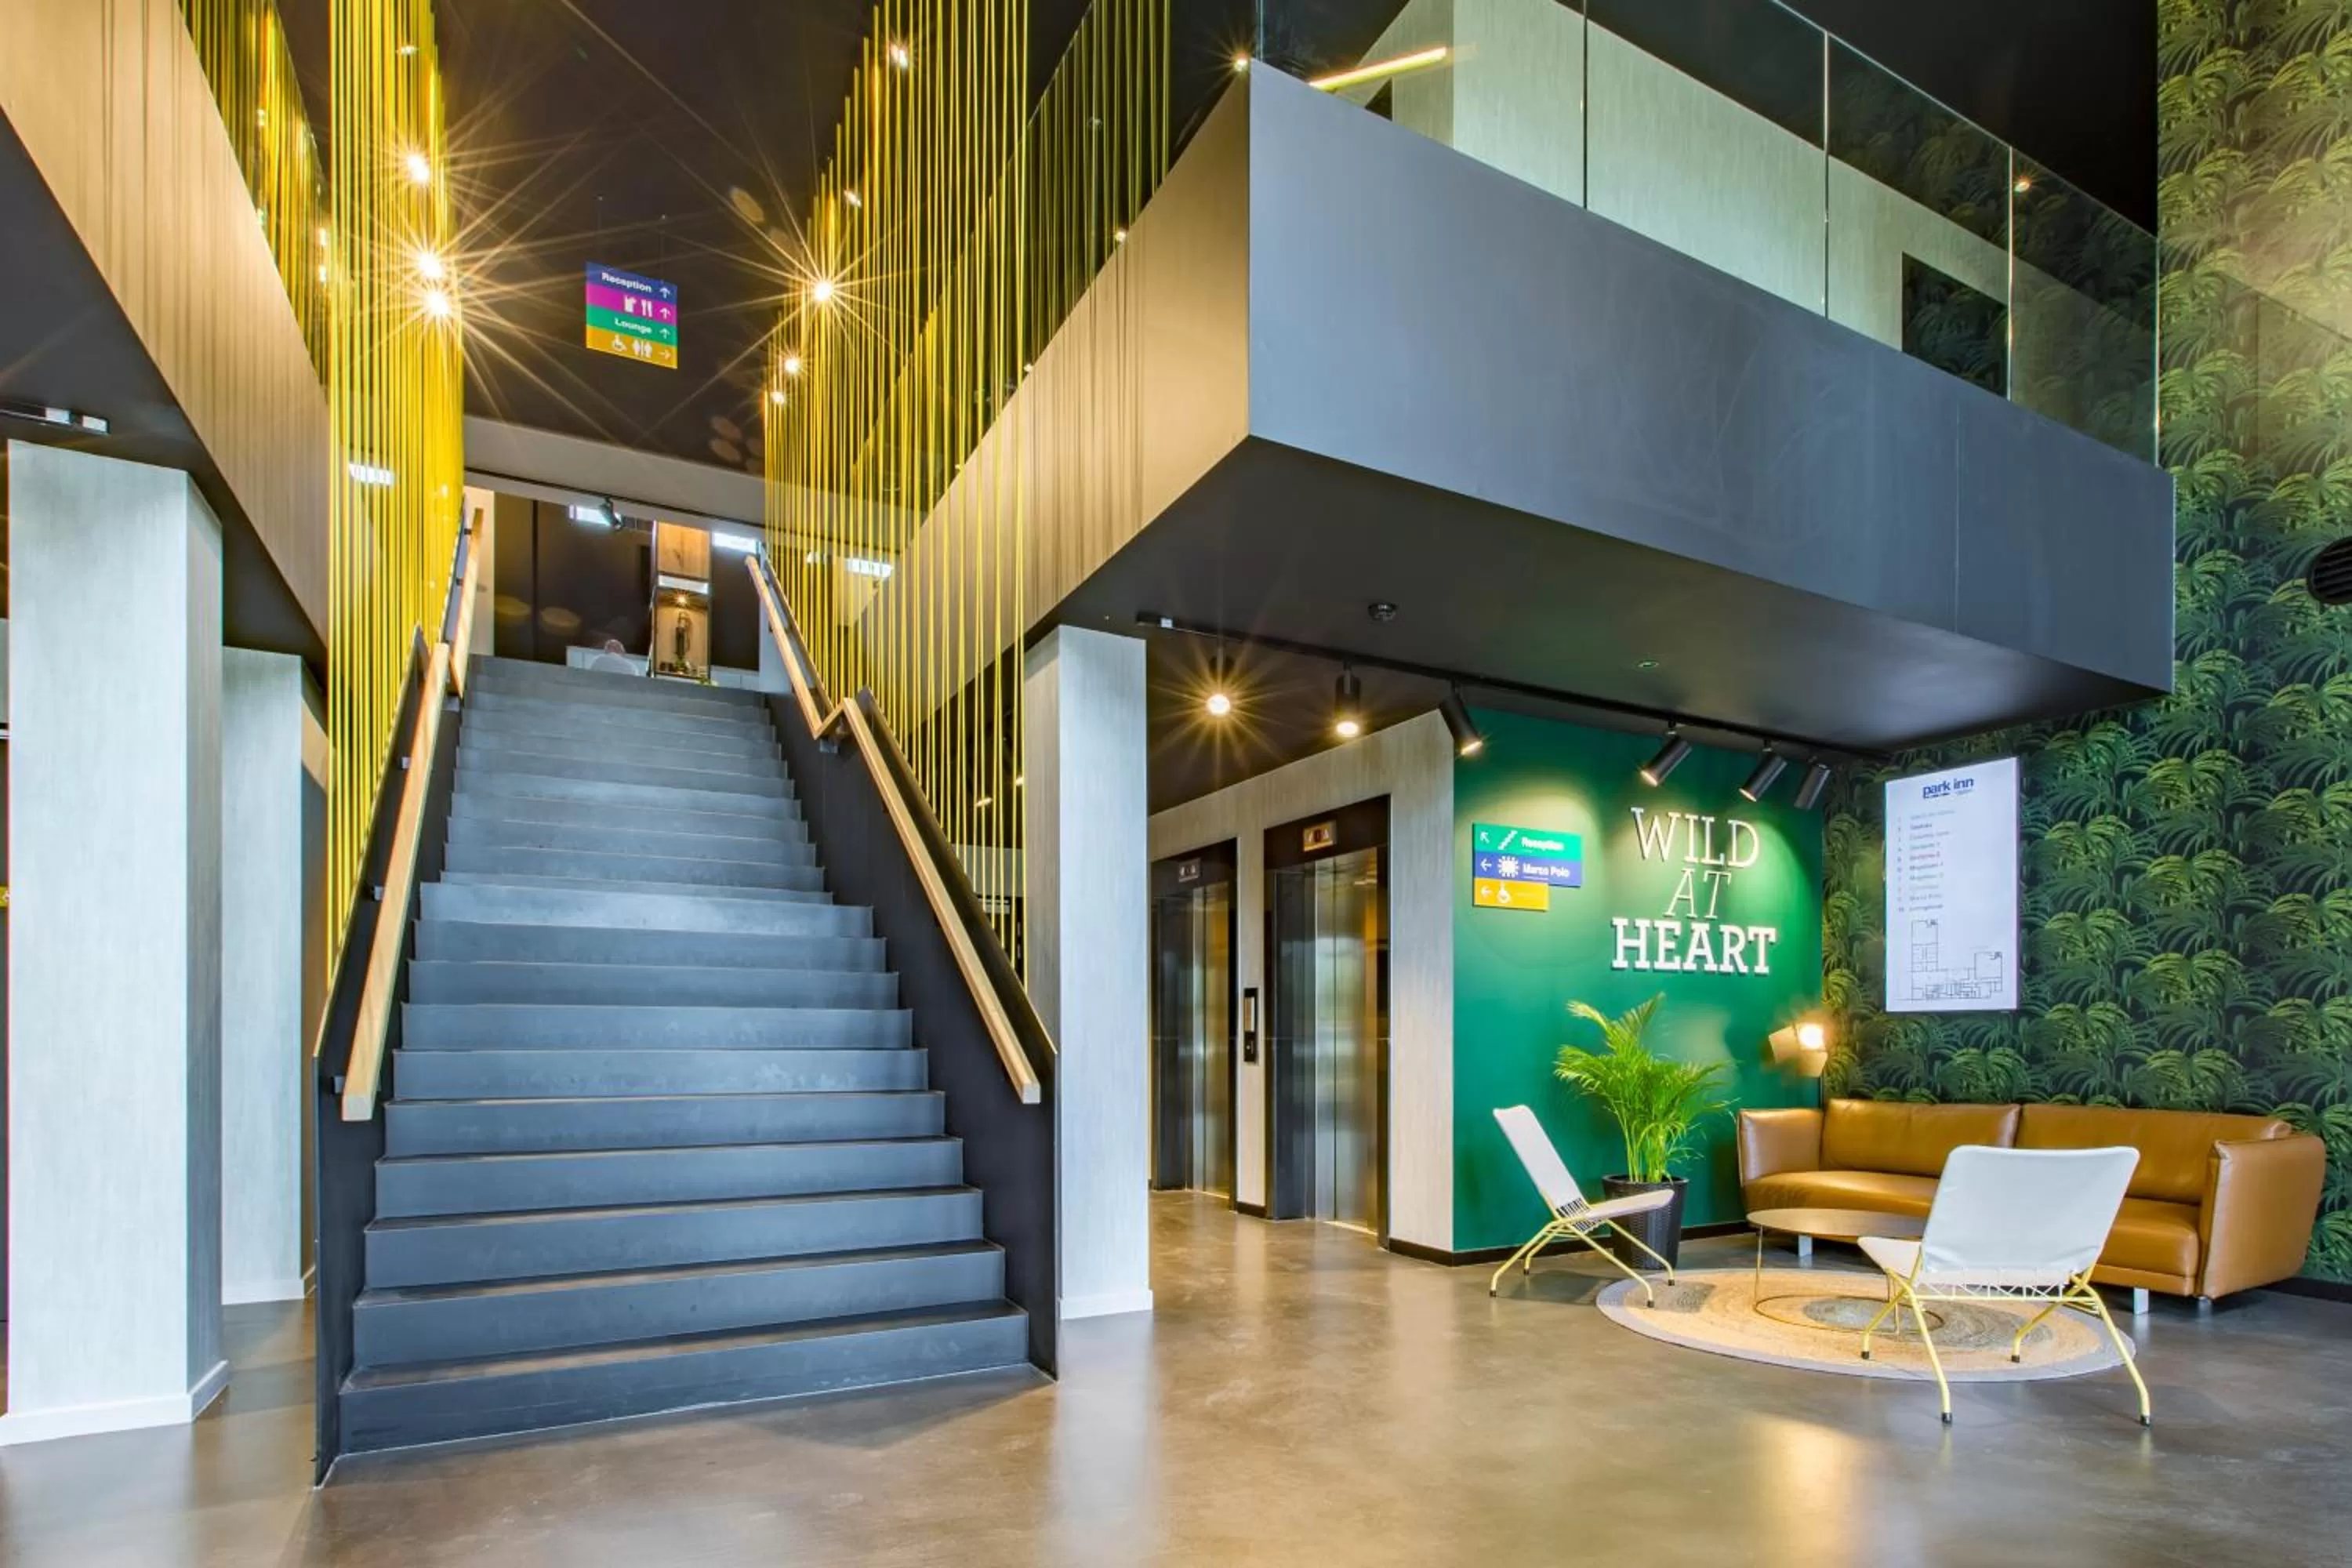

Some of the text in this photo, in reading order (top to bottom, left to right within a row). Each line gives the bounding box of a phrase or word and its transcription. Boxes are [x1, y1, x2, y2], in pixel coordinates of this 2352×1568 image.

[601, 272, 652, 292] Reception
[614, 318, 652, 335] Lounge
[1922, 781, 1951, 799] park
[1954, 777, 1974, 789] inn
[1631, 807, 1760, 868] WILD
[1663, 867, 1732, 920] AT
[1610, 916, 1777, 975] HEART
